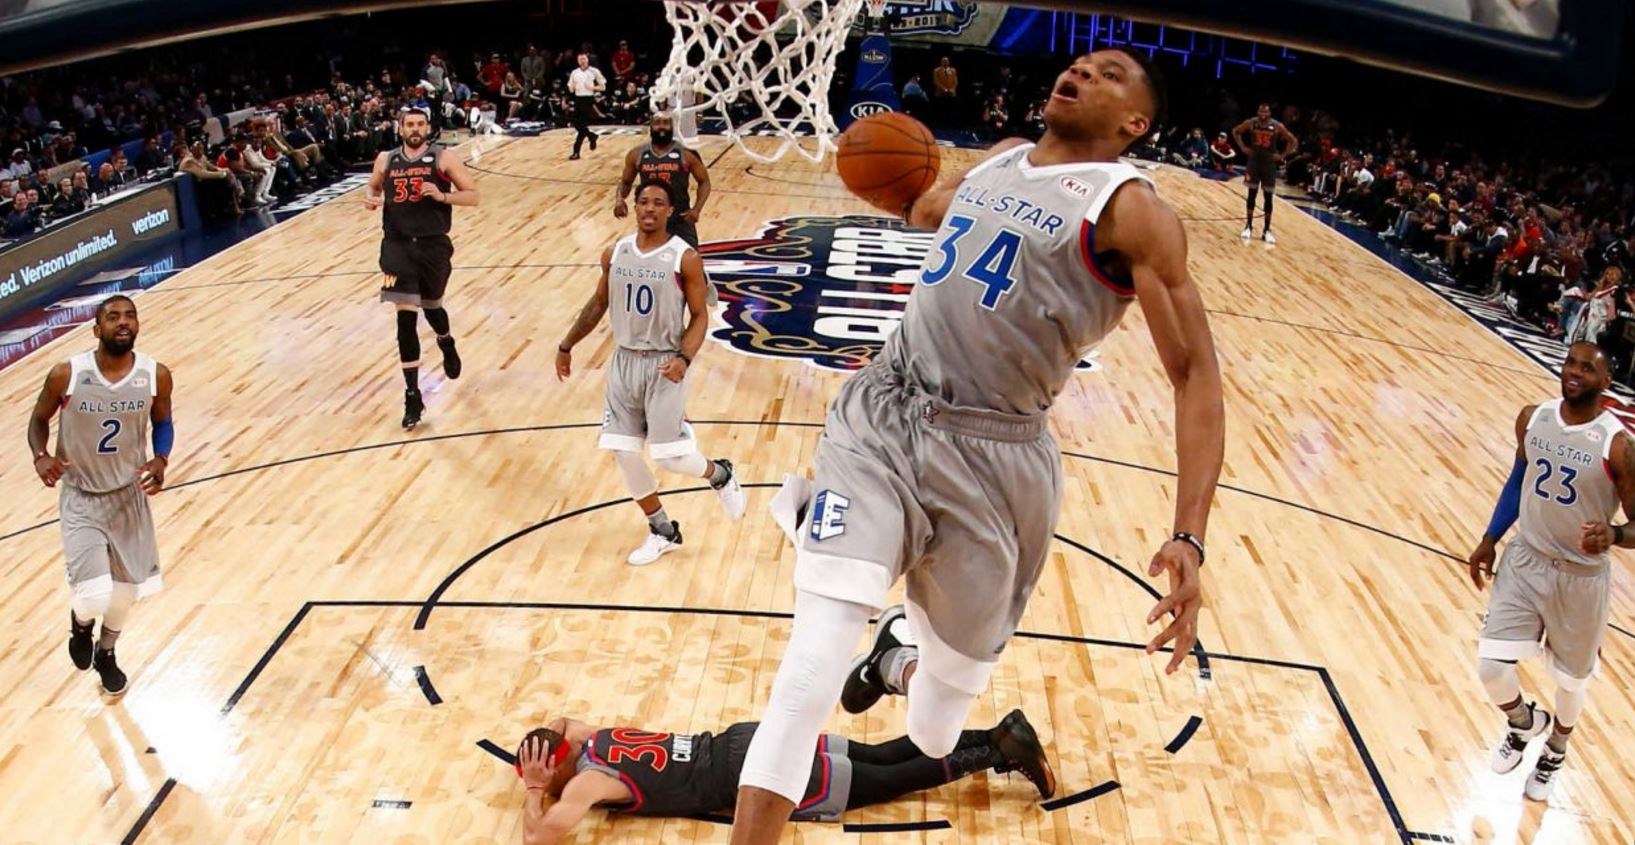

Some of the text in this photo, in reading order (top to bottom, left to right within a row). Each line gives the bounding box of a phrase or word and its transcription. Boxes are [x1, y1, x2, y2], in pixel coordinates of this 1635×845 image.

[393, 177, 424, 202] 33
[132, 208, 169, 235] verizon
[20, 256, 66, 286] Verizon
[65, 229, 117, 267] unlimited.
[920, 213, 1023, 312] 34
[625, 282, 654, 316] 10
[97, 418, 121, 454] 2
[1534, 457, 1578, 506] 23
[811, 489, 852, 541] E
[607, 727, 671, 773] 30
